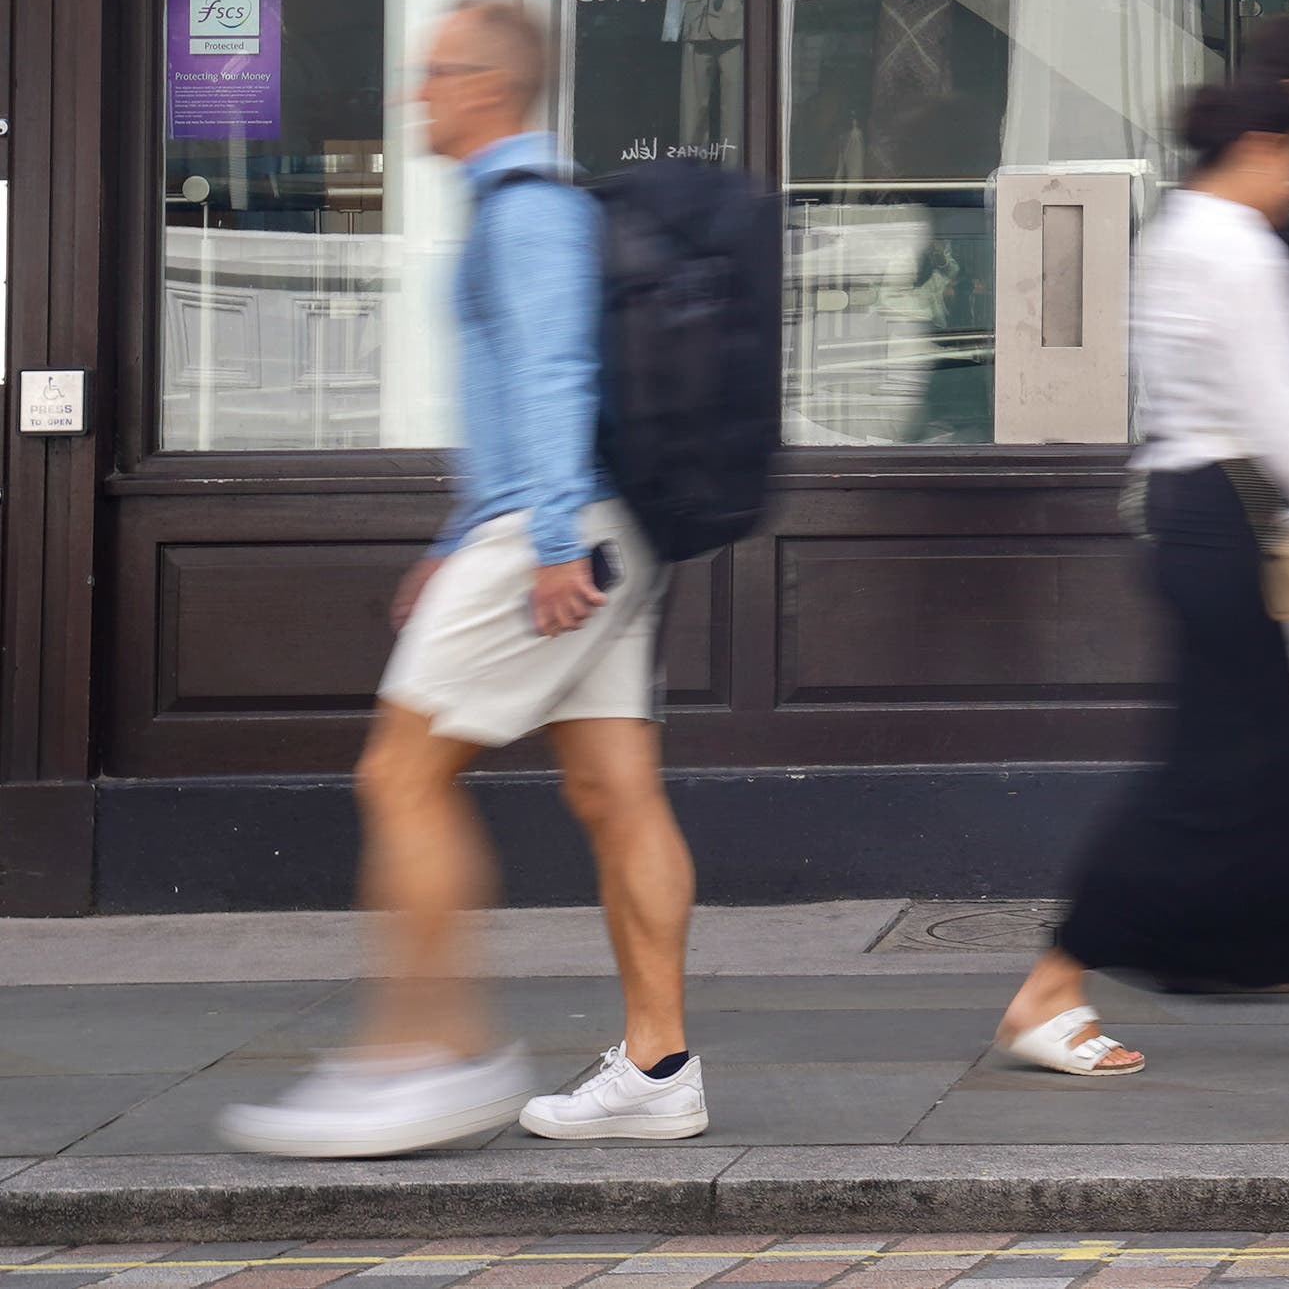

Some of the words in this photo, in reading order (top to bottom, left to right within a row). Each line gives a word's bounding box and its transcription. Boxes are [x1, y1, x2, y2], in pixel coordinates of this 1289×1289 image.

[204, 41, 244, 50] Protected
[175, 71, 218, 82] Protecting
[220, 72, 240, 81] Your
[241, 72, 271, 82] Money
[30, 419, 41, 427] TO
[48, 418, 73, 426] OPEN
